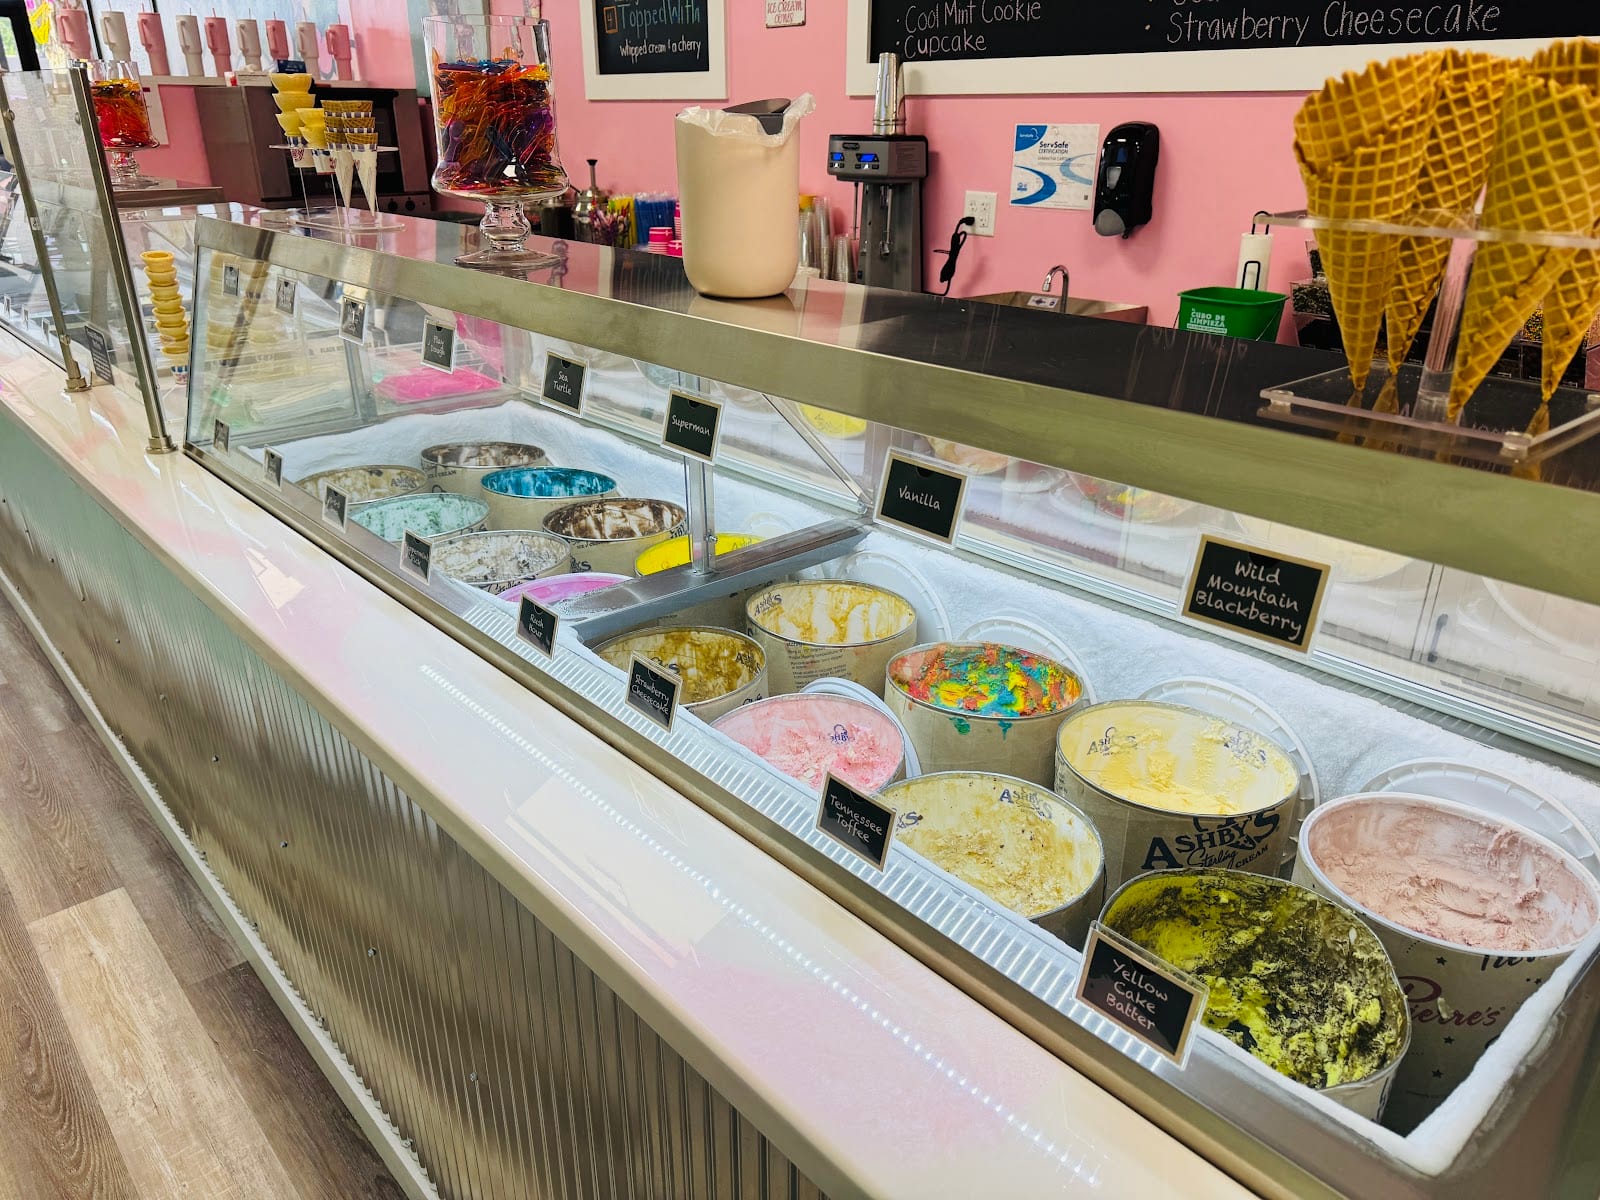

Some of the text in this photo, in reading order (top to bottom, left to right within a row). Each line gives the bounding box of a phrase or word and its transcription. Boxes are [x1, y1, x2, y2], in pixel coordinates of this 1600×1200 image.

[905, 0, 1042, 34] Cool Mint Cookie
[1167, 7, 1309, 46] Strawberry
[1323, 0, 1500, 37] Cheesecake
[620, 38, 648, 64] whipped
[648, 42, 667, 54] cream
[678, 34, 701, 60] cherry
[904, 28, 987, 59] Cupcake
[1039, 140, 1069, 149] ServSafe
[1190, 317, 1226, 328] LIMPIEZA
[1215, 314, 1226, 322] DE
[553, 380, 572, 395] Turtle
[558, 371, 569, 383] Sea
[671, 414, 711, 436] Superman
[899, 485, 940, 511] Vanilla
[1234, 561, 1281, 585] Wild
[1207, 574, 1299, 612] Mountain
[530, 613, 544, 629] Rush
[1195, 590, 1302, 641] Blackberry
[631, 684, 669, 715] Cheesecake
[635, 674, 670, 707] Strawberry
[830, 793, 883, 836] Tennessee
[836, 812, 870, 843] Toffee
[1140, 808, 1281, 870] ASHBY'S
[1186, 848, 1238, 870] Sterling
[1113, 959, 1169, 1002] Yellow
[1106, 992, 1156, 1030] Batter
[1113, 981, 1156, 1014] Cake
